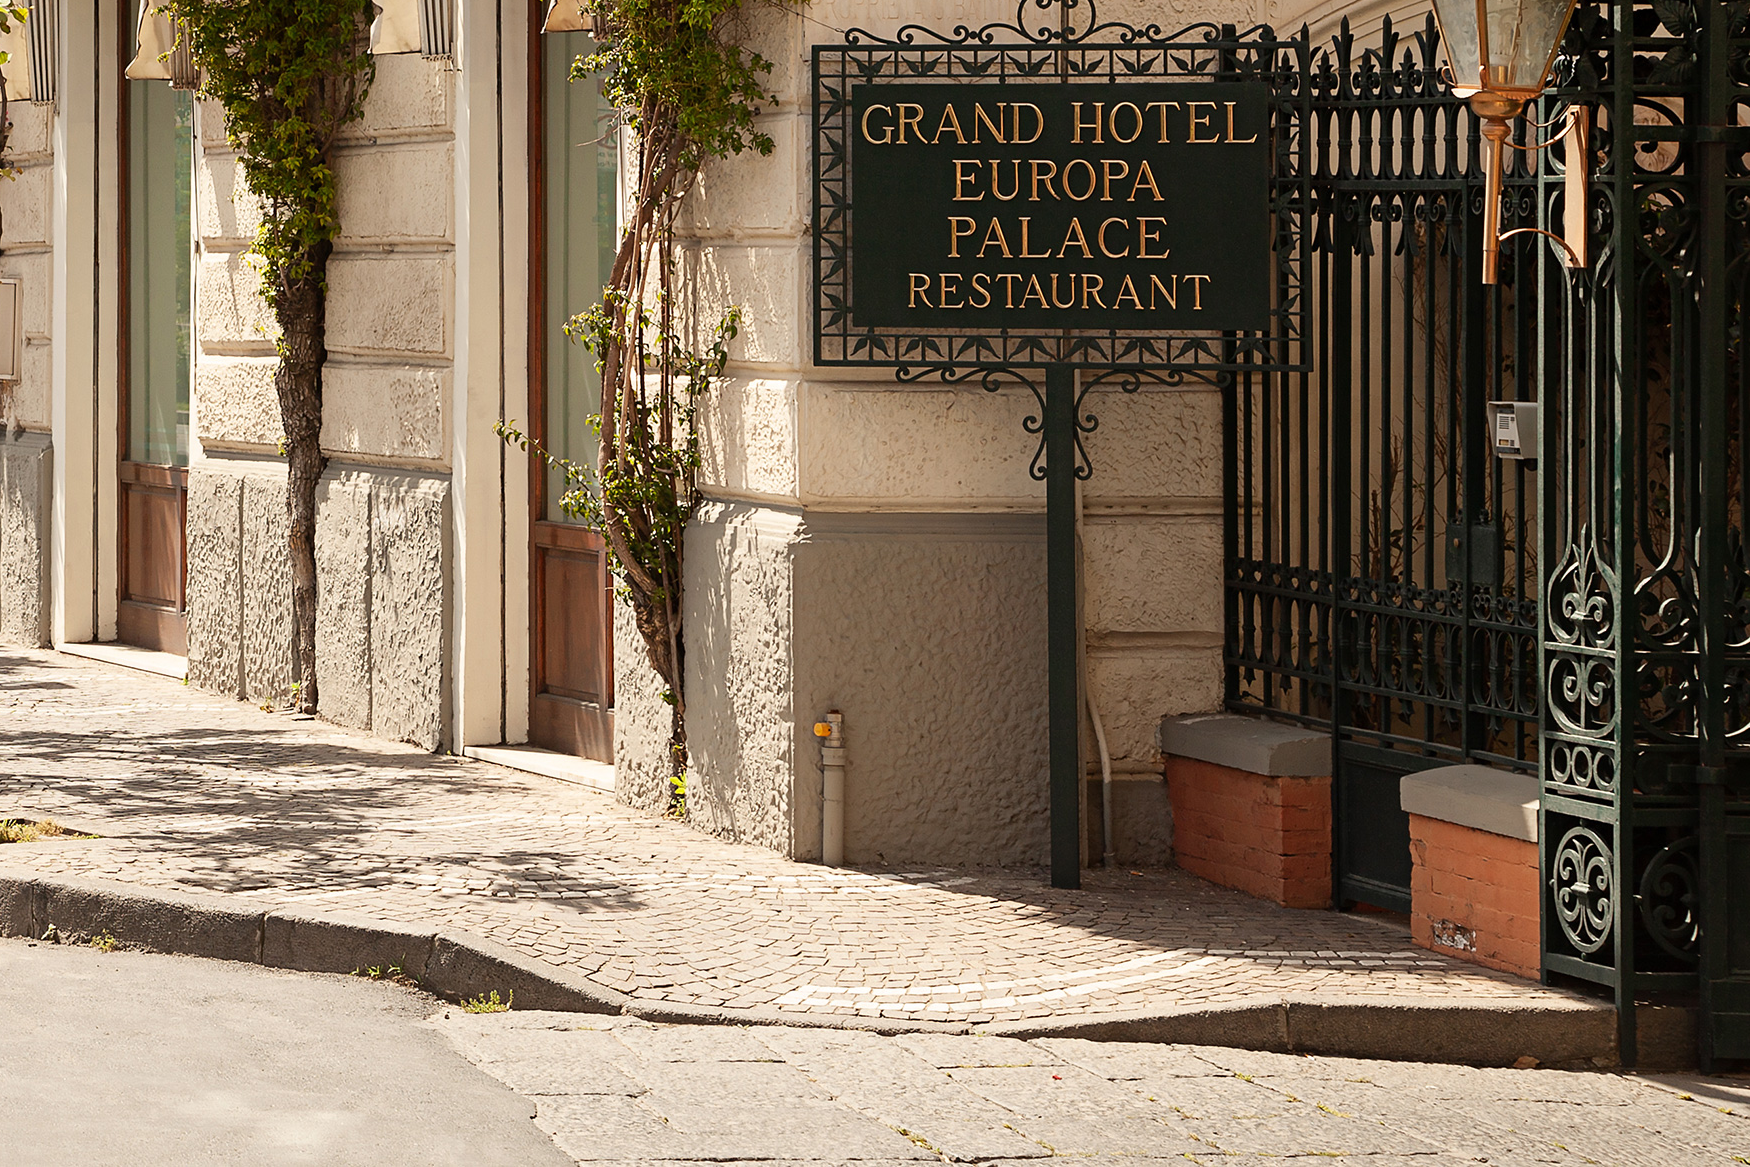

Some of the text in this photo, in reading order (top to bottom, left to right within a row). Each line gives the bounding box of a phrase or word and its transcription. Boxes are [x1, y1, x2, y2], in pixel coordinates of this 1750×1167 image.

[861, 100, 1258, 145] GRAND HOTEL
[952, 158, 1165, 202] EUROPA
[947, 215, 1171, 259] PALACE
[907, 271, 1212, 311] RESTAURANT
